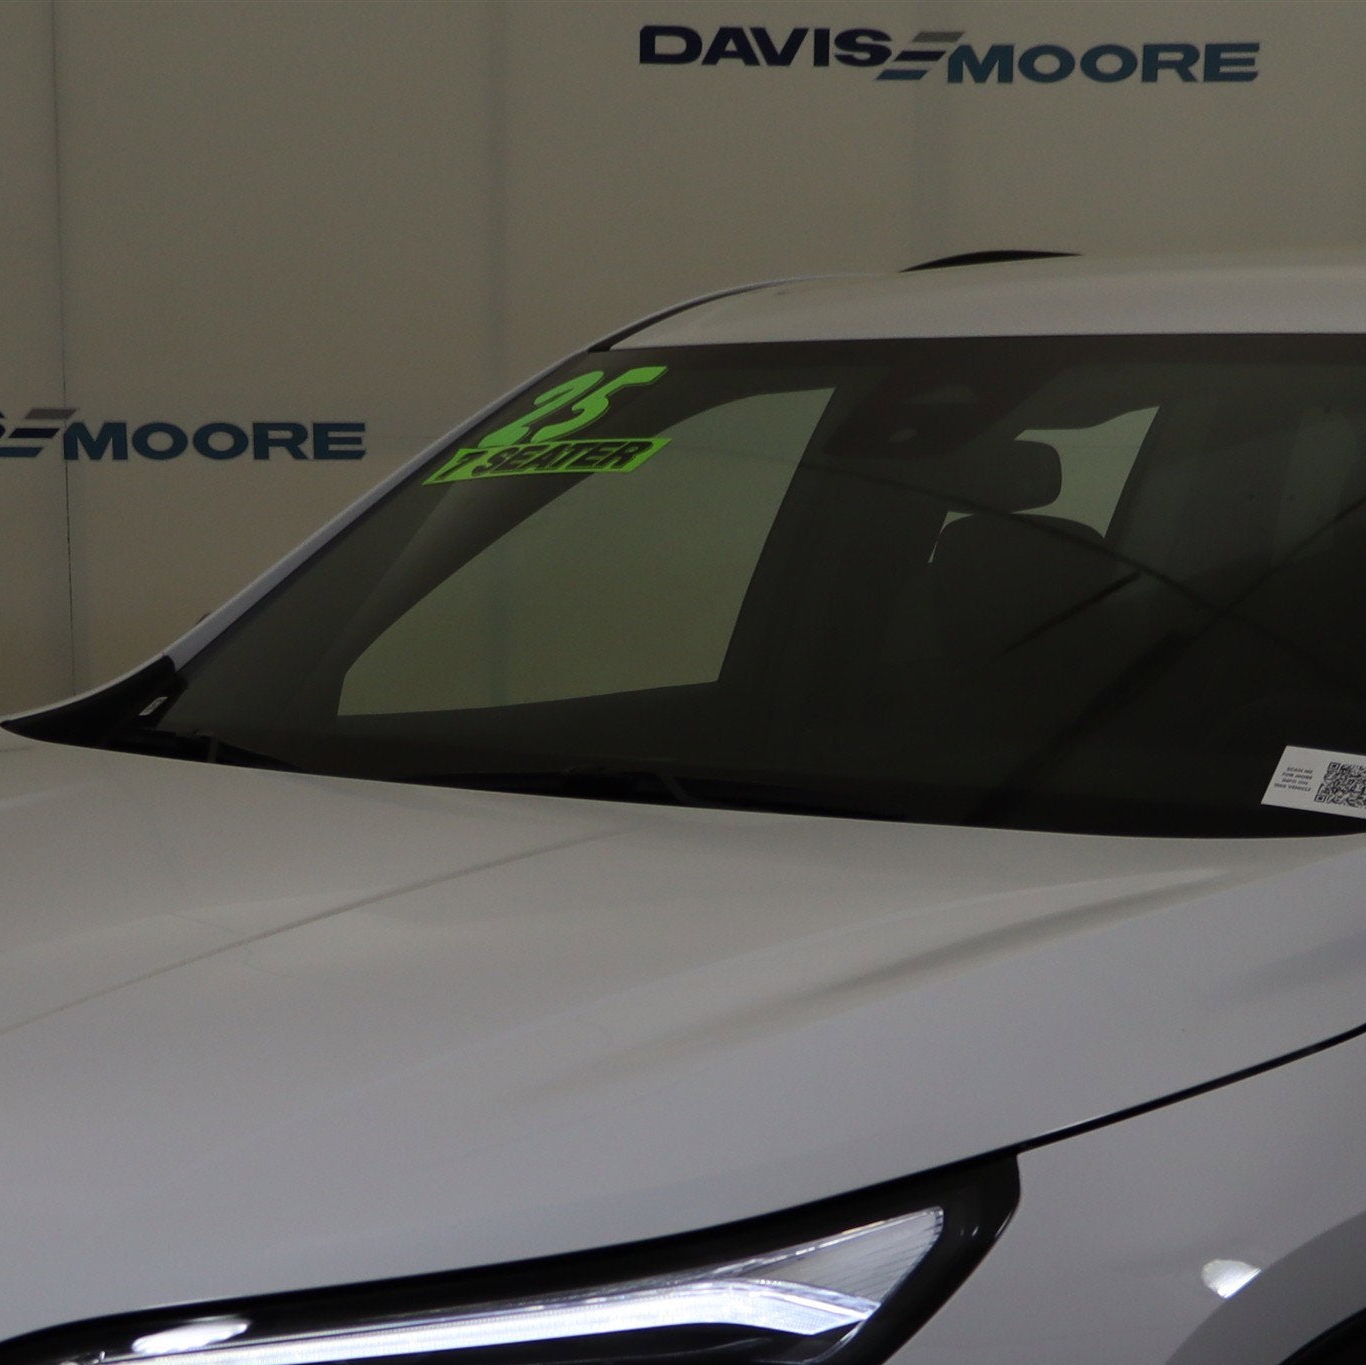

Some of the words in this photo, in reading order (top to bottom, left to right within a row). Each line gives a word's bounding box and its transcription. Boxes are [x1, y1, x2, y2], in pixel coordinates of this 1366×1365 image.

[639, 25, 894, 67] DAVIS
[947, 43, 1260, 84] MOORE
[478, 366, 668, 448] 25
[63, 422, 366, 460] MOORE
[472, 441, 652, 476] SEATER
